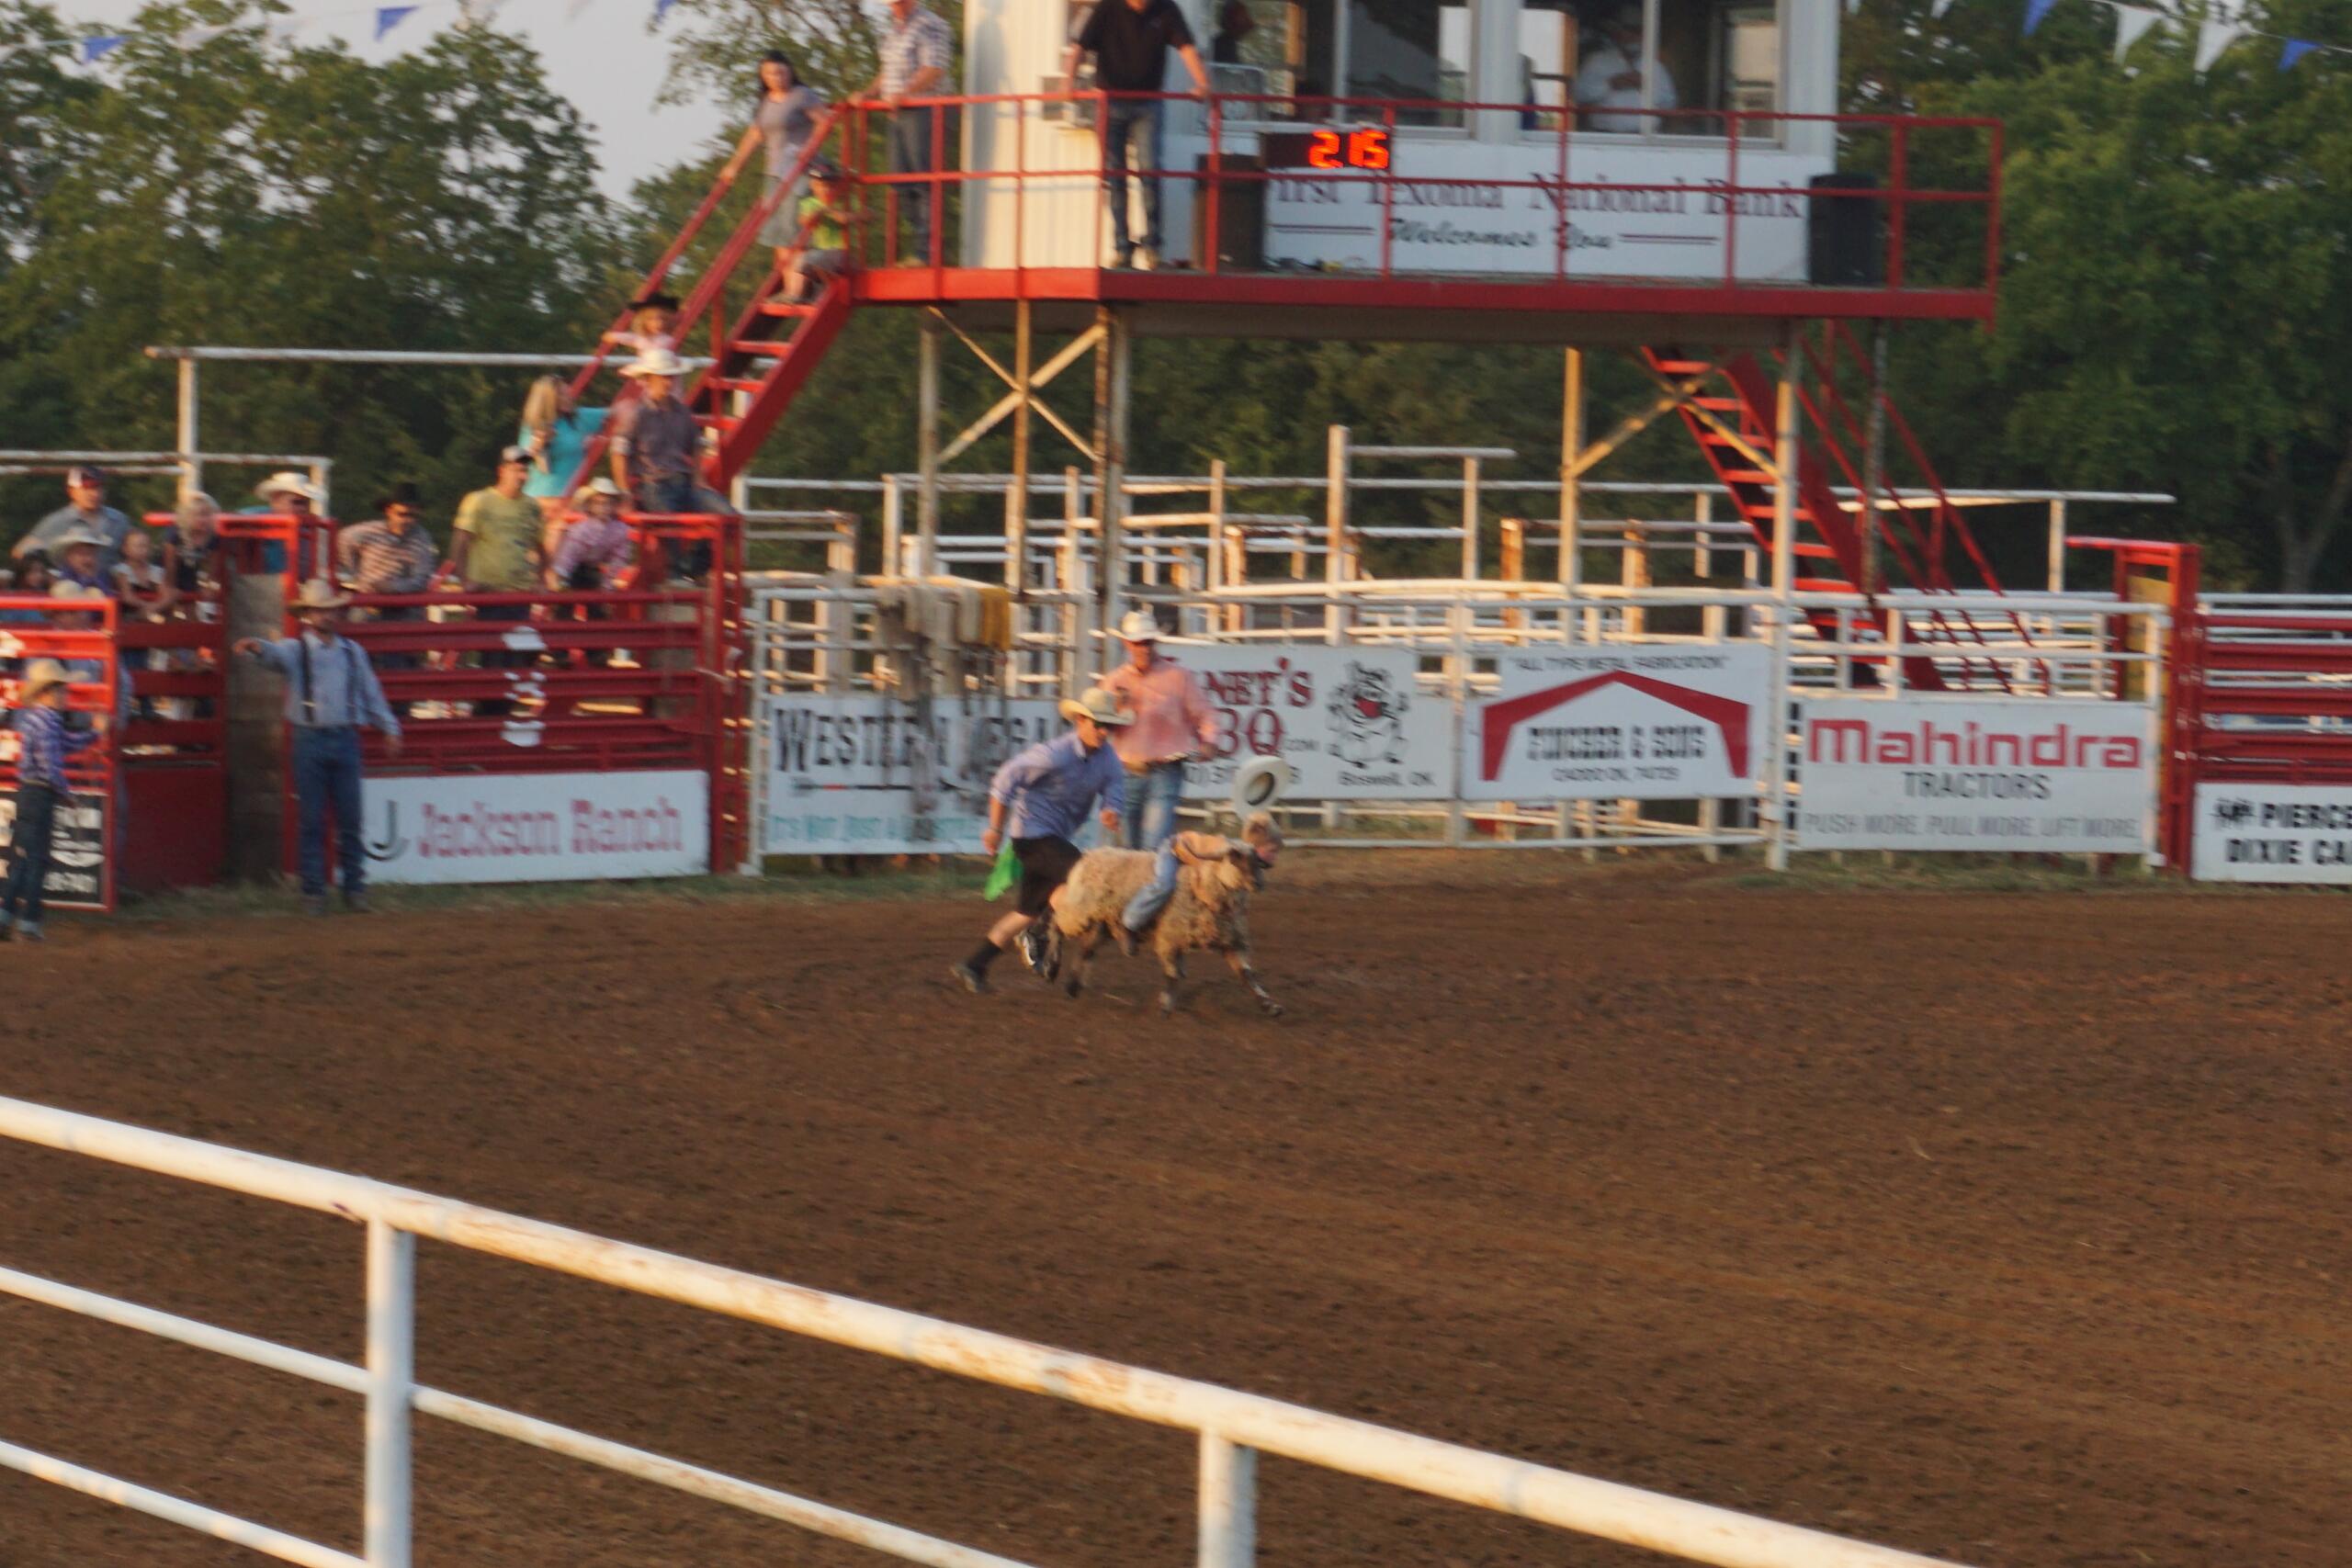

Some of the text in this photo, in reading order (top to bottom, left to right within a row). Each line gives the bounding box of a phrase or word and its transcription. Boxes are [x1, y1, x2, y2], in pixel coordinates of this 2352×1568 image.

[1528, 172, 1687, 213] National
[1702, 176, 1806, 218] Bank
[1808, 718, 2143, 770] Mahindra
[1904, 772, 2052, 801] TRACTORS
[419, 796, 684, 858] Jackson Ranch
[1805, 813, 1859, 835] PUSH
[1928, 815, 1975, 837] PULL
[2225, 838, 2303, 864] DIXIE
